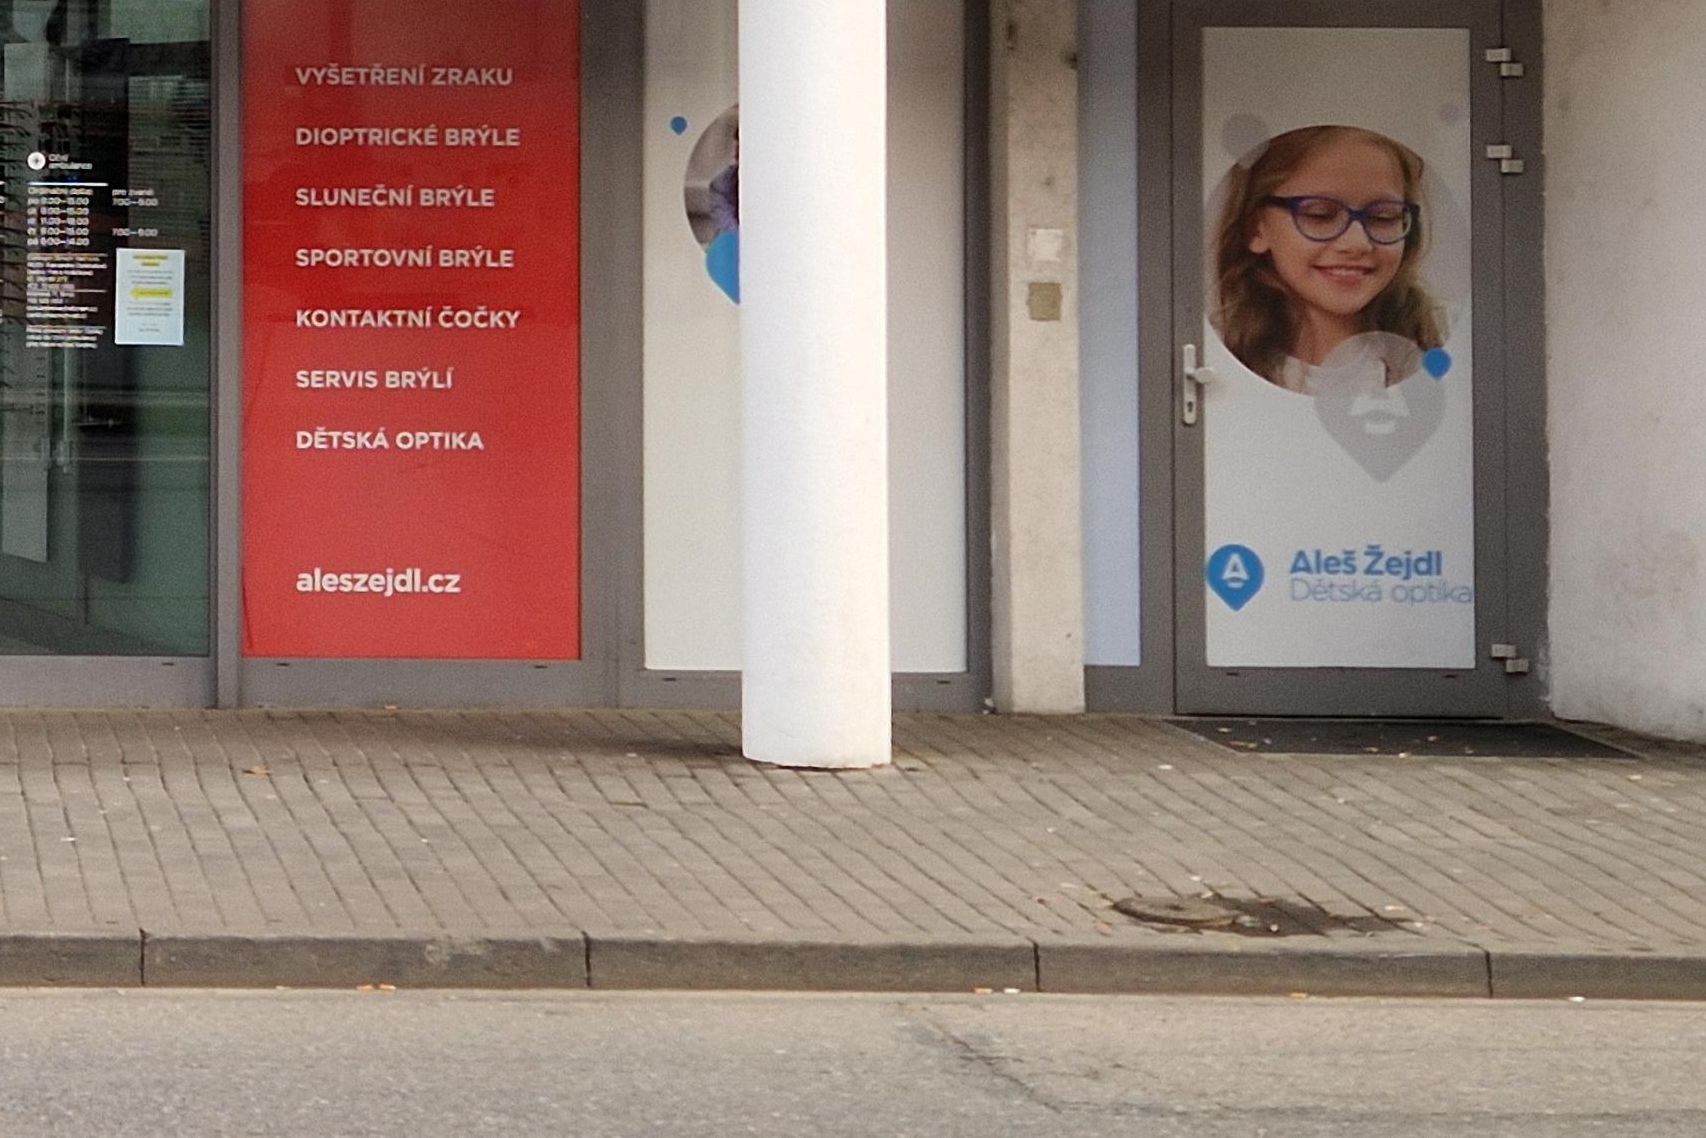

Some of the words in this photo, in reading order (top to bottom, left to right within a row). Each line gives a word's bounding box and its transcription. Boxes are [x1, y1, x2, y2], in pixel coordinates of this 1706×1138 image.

[295, 62, 426, 87] VYŠETŘENÍ
[431, 67, 513, 87] ZRAKU
[295, 122, 439, 148] DIOPTRICKÉ
[444, 122, 521, 148] BRÝLE
[295, 183, 414, 208] SLUNEČNÍ
[419, 183, 496, 208] BRÝLE
[295, 244, 433, 268] SPORTOVNÍ
[438, 244, 515, 268] BRÝLE
[295, 304, 433, 329] KONTAKTNÍ
[437, 304, 521, 329] ČOČKY
[295, 369, 379, 390] SERVIS
[384, 365, 455, 390] BRÝLÍ
[295, 425, 391, 450] DĚTSKÁ
[395, 430, 485, 451] OPTIKA
[1290, 549, 1357, 576] Aleš
[1363, 544, 1444, 581] Žejdl
[295, 566, 462, 598] aleszejdl.cz
[1290, 577, 1383, 602] Dětská
[1390, 579, 1473, 606] optika
